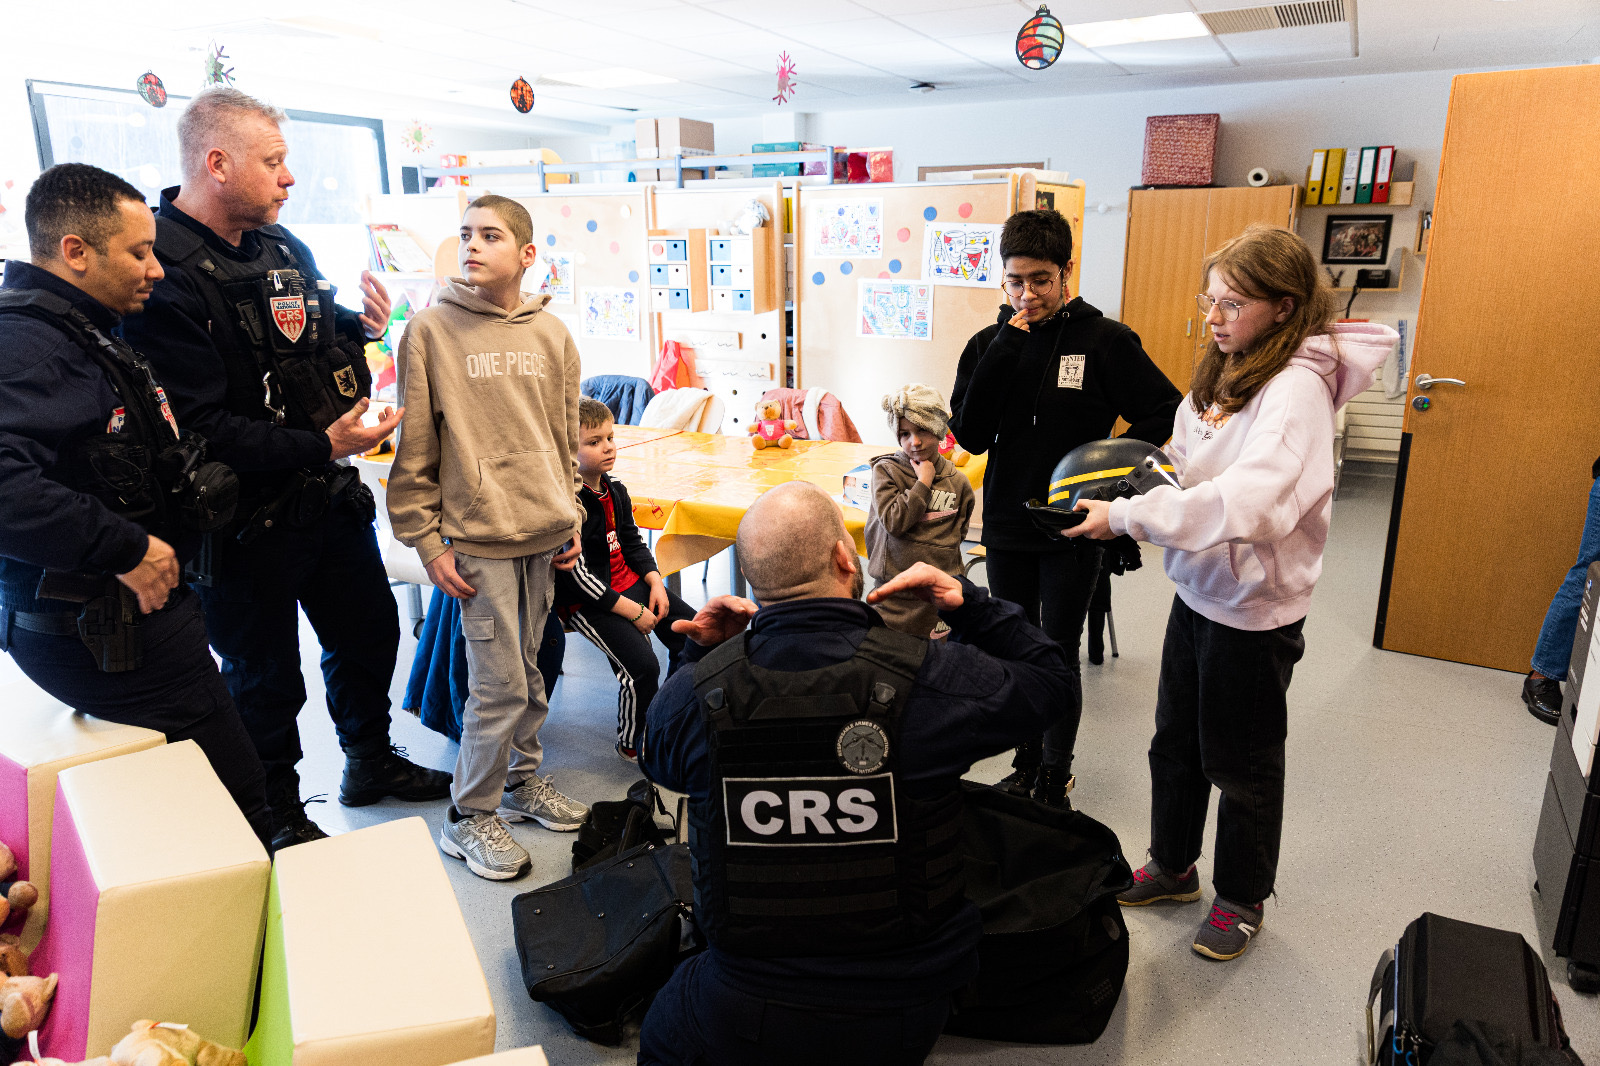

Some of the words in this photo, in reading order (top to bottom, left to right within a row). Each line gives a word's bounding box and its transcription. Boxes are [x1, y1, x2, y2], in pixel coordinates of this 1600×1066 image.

[278, 310, 302, 321] CRS
[466, 352, 503, 379] ONE
[505, 351, 546, 378] PIECE
[927, 489, 957, 512] IKE
[740, 788, 879, 836] CRS
